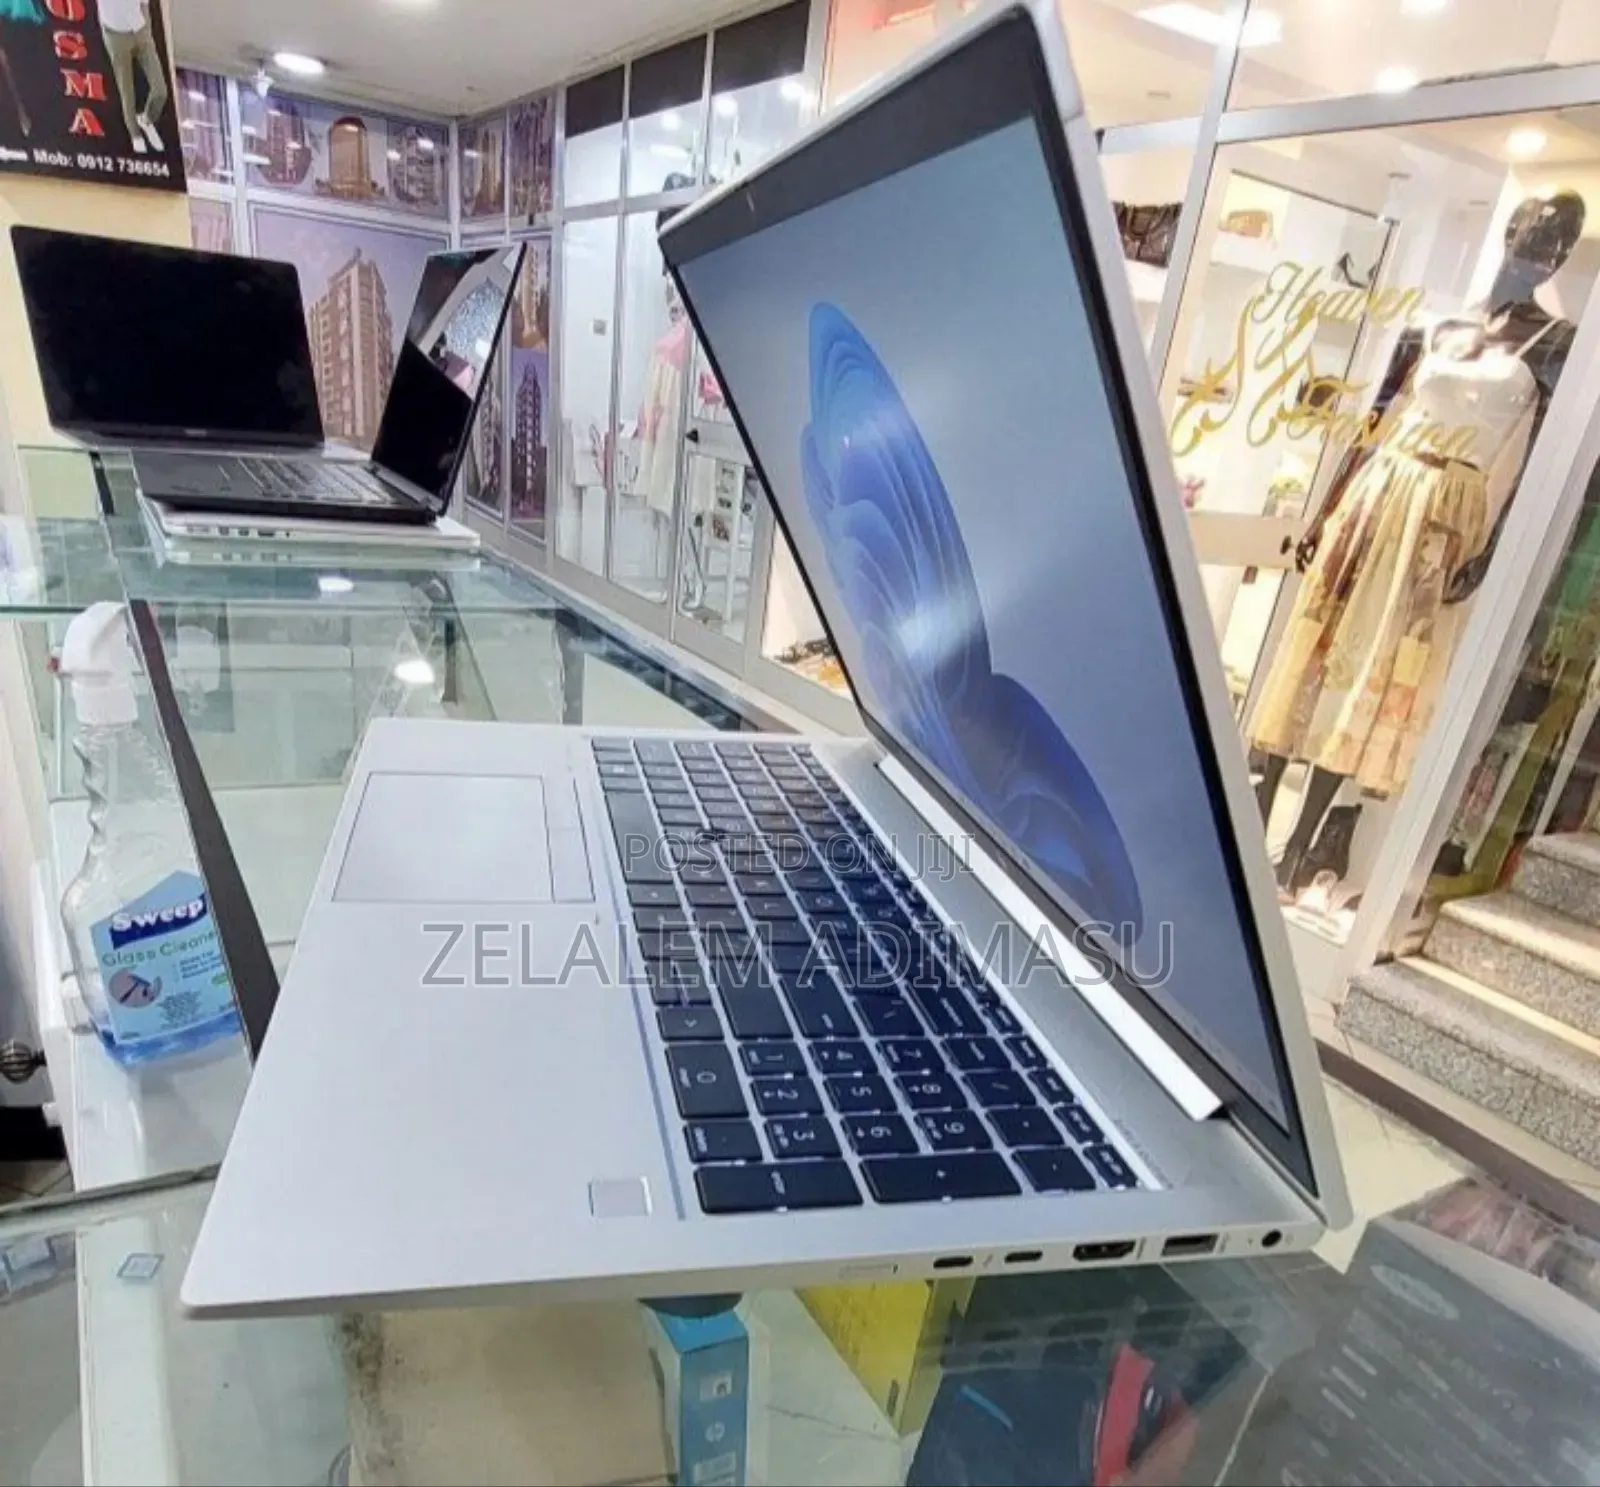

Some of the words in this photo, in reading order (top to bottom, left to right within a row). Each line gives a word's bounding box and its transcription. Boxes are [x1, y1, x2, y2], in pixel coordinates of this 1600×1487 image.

[33, 148, 74, 168] Mob:
[77, 153, 114, 172] 0912
[1251, 261, 1424, 326] Heaven
[111, 898, 204, 932] Sweep
[102, 950, 157, 967] Glass
[792, 1129, 816, 1142] 3
[870, 1126, 892, 1139] 6
[943, 1121, 965, 1134] 9
